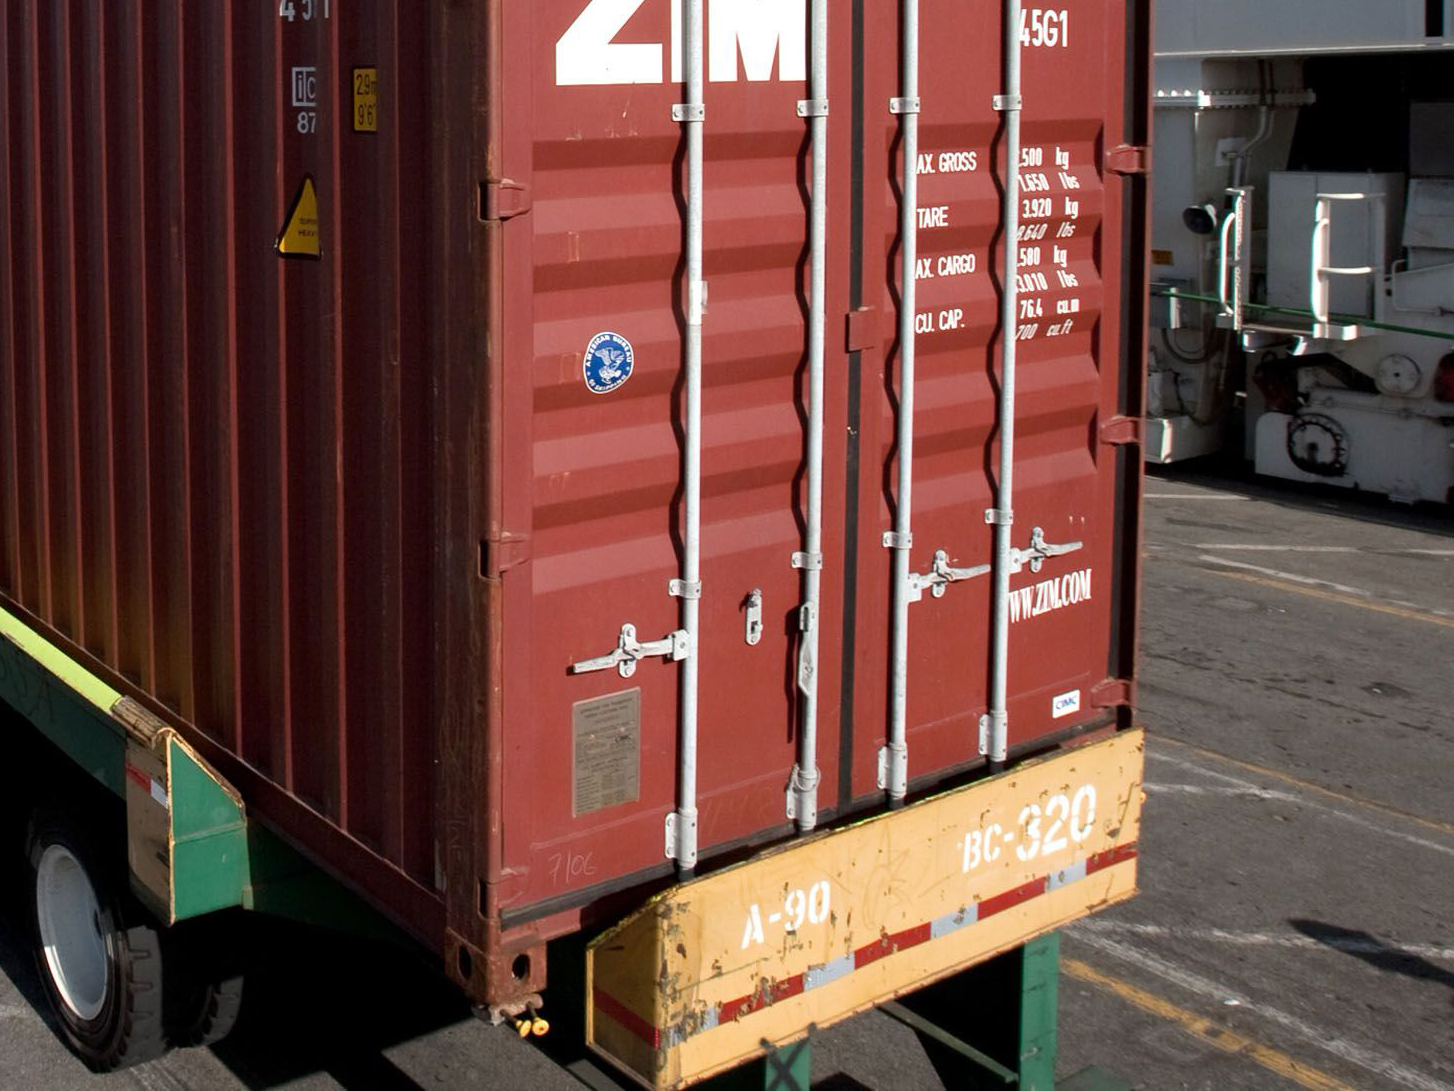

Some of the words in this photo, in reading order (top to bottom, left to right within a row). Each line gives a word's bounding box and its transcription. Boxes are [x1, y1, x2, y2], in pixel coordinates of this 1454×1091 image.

[1019, 9, 1069, 48] 45G1
[916, 153, 936, 175] AX.
[938, 151, 978, 173] GROSS
[1018, 148, 1043, 168] .500
[1055, 146, 1070, 170] kg
[1058, 172, 1081, 190] lbs
[917, 206, 949, 229] TARE
[1022, 198, 1052, 219] 3.920
[1064, 196, 1079, 220] kg
[1056, 221, 1076, 239] lbs
[915, 258, 935, 280] AX.
[937, 254, 976, 277] CARGO
[1017, 246, 1041, 268] .580
[1053, 245, 1068, 268] kg
[1056, 270, 1079, 288] lbs
[915, 313, 935, 334] CU.
[938, 308, 966, 331] CAP.
[1019, 298, 1044, 320] 76.4
[1009, 568, 1092, 624] WW.ZIM.COM
[961, 784, 1097, 873] BC-320
[740, 880, 832, 951] A-90
